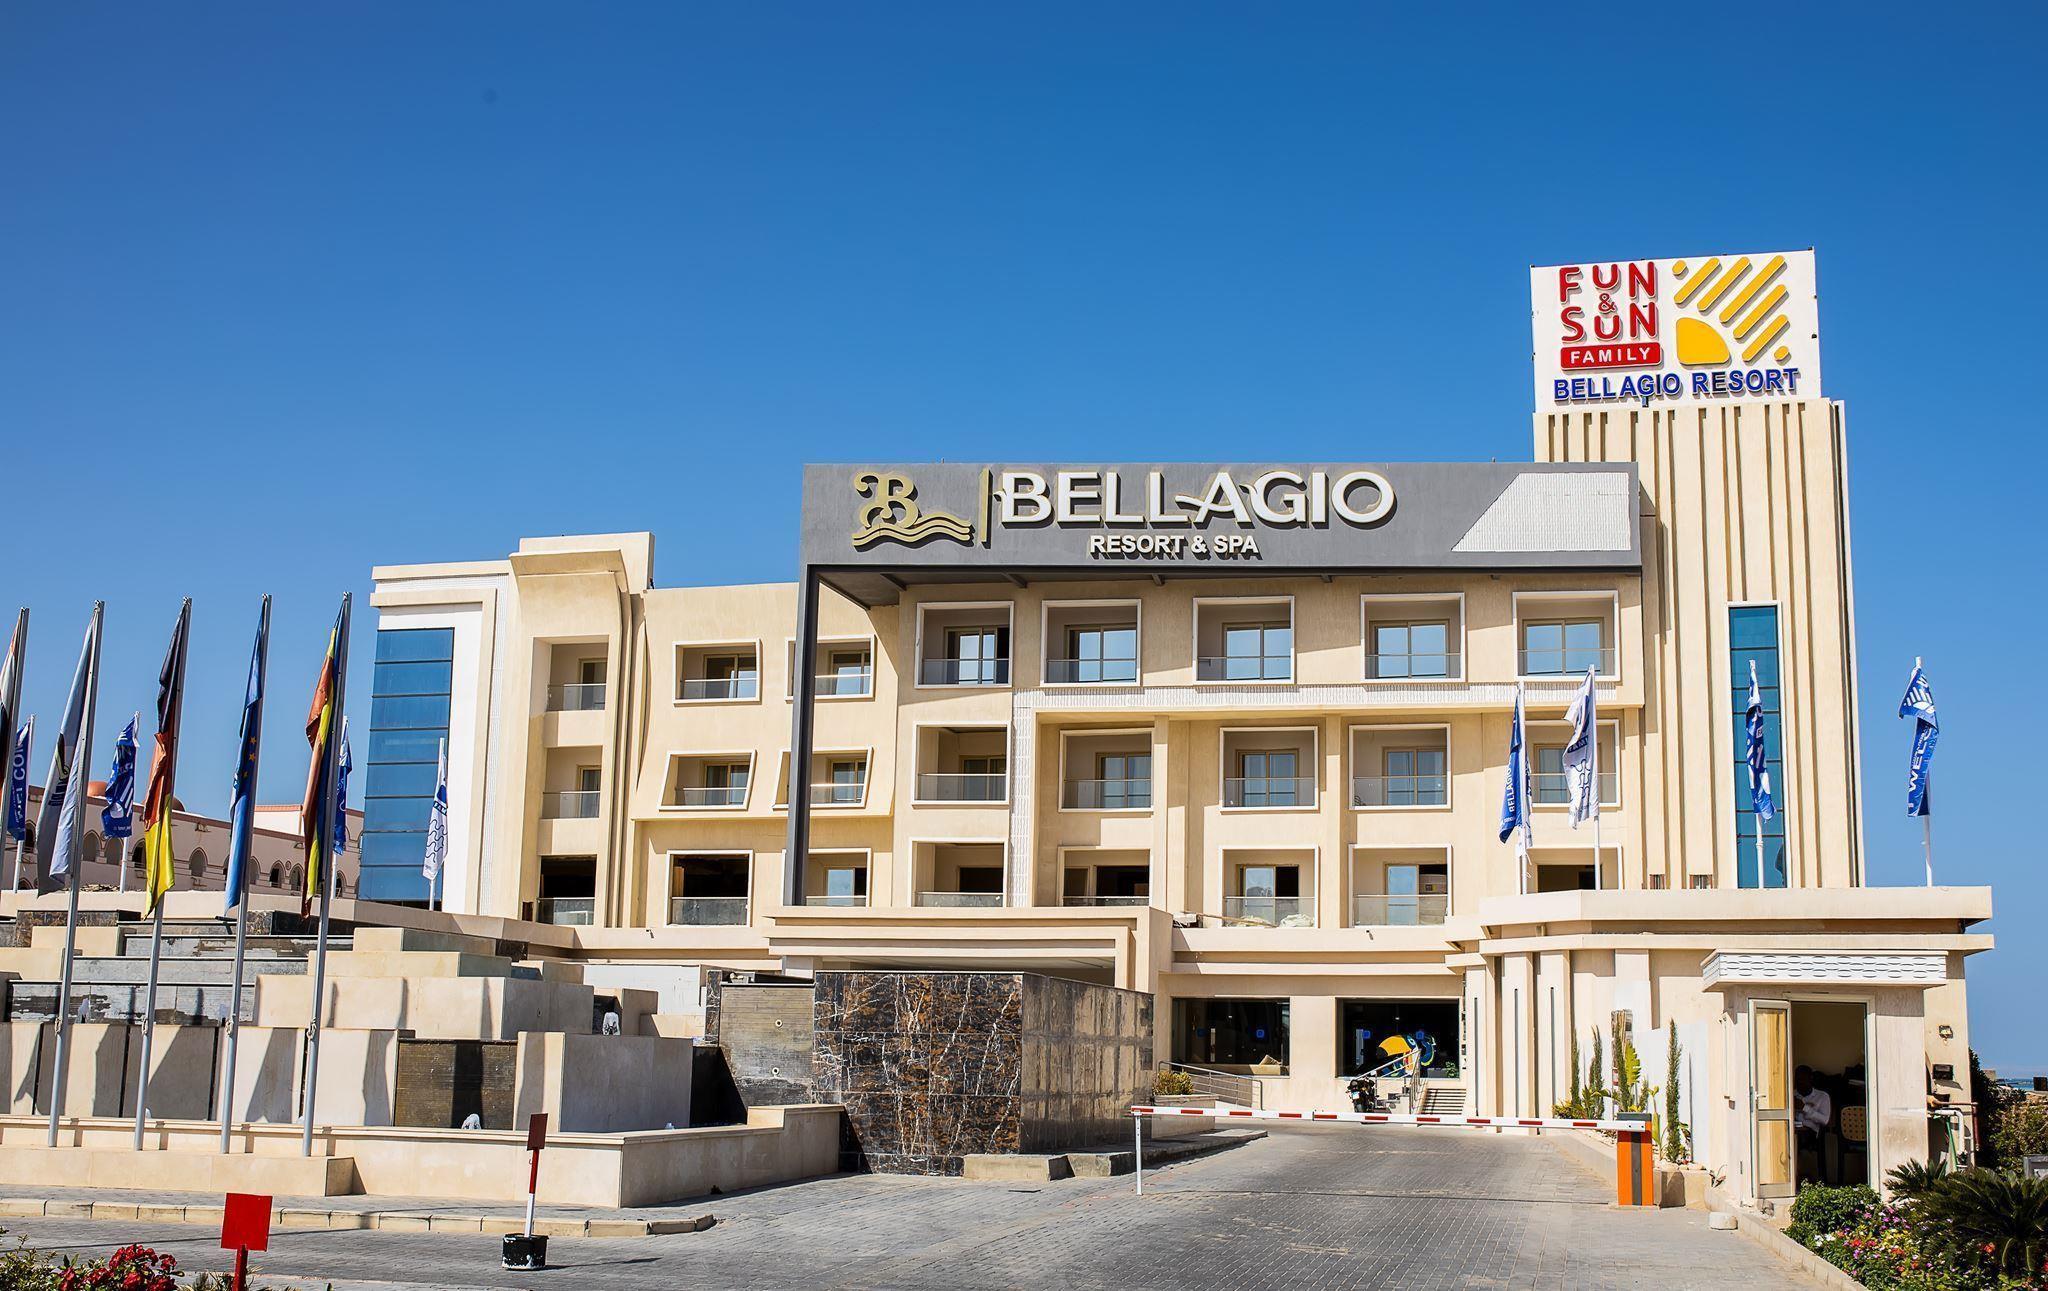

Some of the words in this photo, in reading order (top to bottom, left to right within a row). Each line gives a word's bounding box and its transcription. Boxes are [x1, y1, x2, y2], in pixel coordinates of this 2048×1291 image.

[1559, 261, 1656, 303] FUN
[1598, 293, 1616, 313] &
[1560, 301, 1657, 342] SUN
[1570, 347, 1650, 364] FAMILY
[1553, 373, 1681, 400] BELLAGIO
[1691, 368, 1798, 393] RESORT
[993, 470, 1395, 524] BELLAGIO
[1090, 535, 1185, 553] RESORT
[1191, 535, 1207, 553] &
[1213, 535, 1259, 553] SPA
